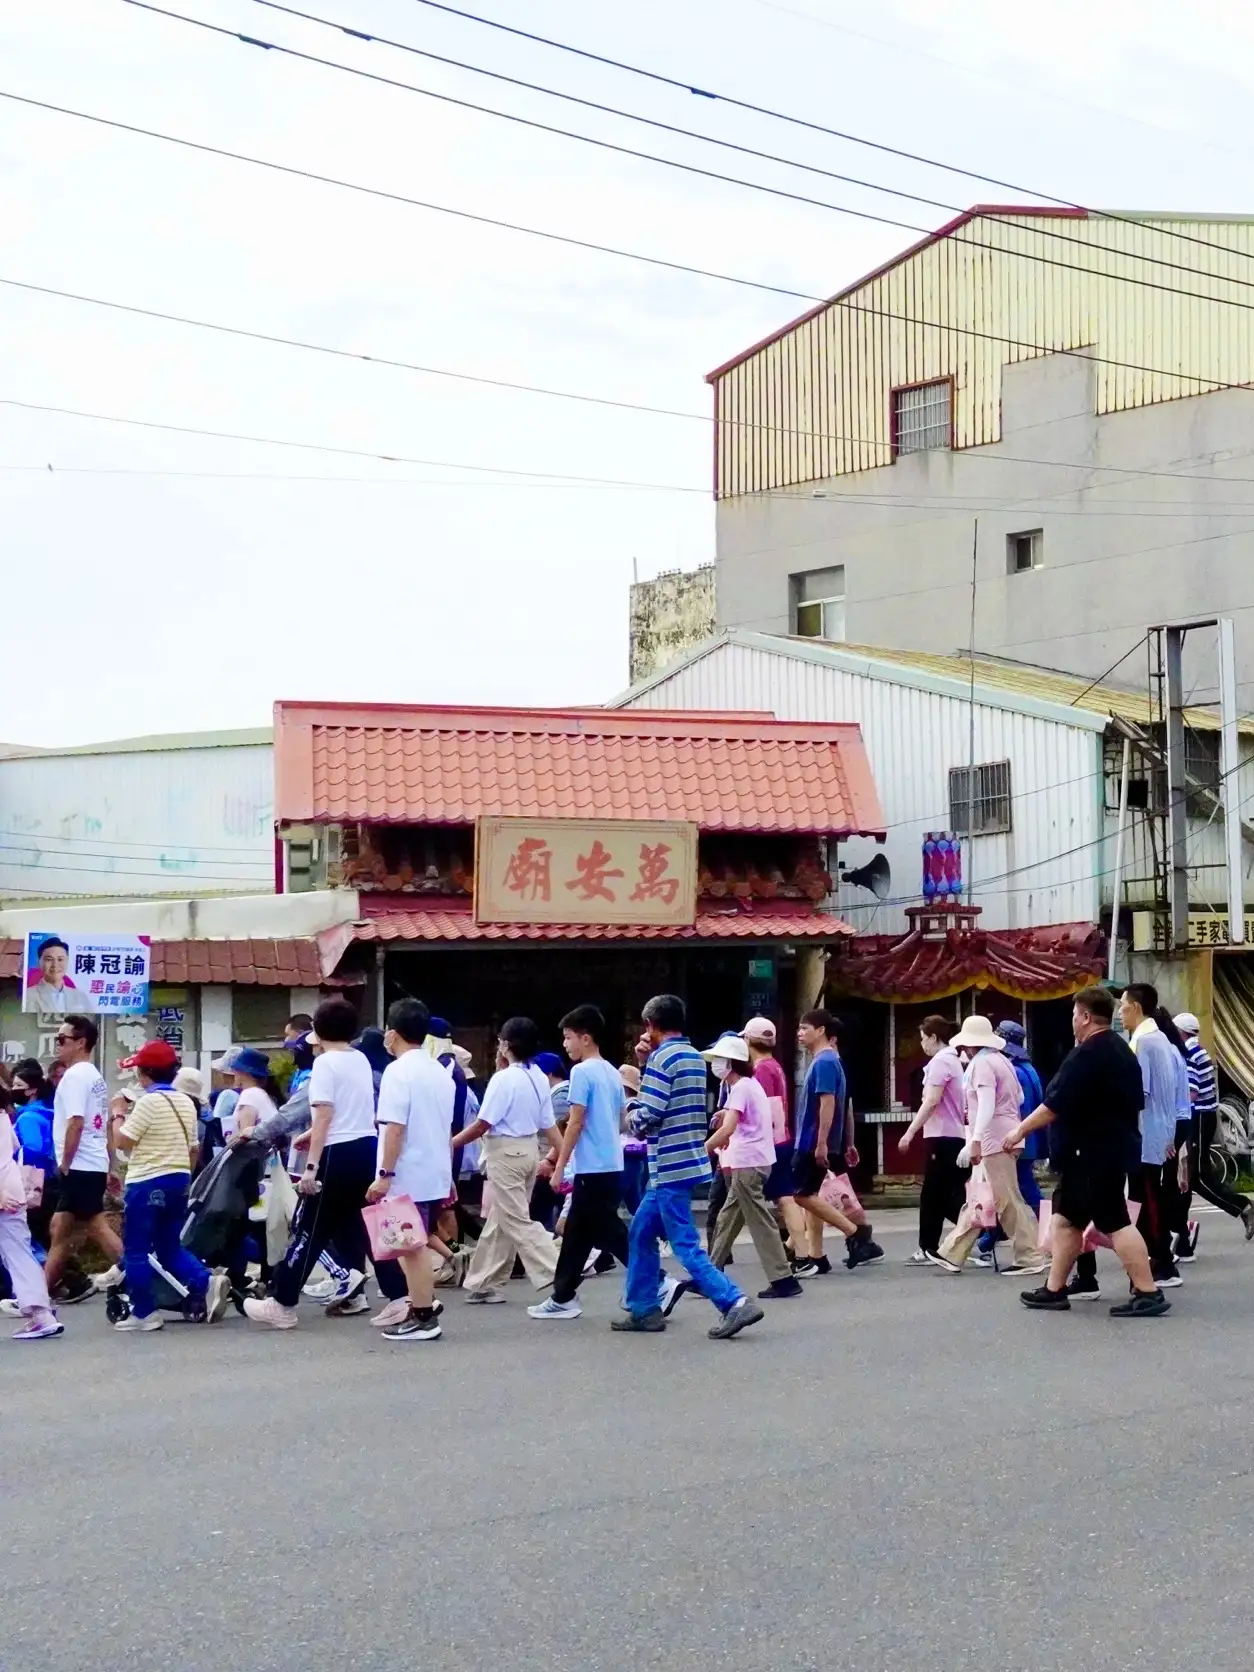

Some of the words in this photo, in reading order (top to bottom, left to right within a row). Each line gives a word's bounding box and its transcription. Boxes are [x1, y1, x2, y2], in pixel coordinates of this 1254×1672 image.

[502, 837, 680, 905] 萬安廟
[75, 953, 145, 976] 陳冠諭
